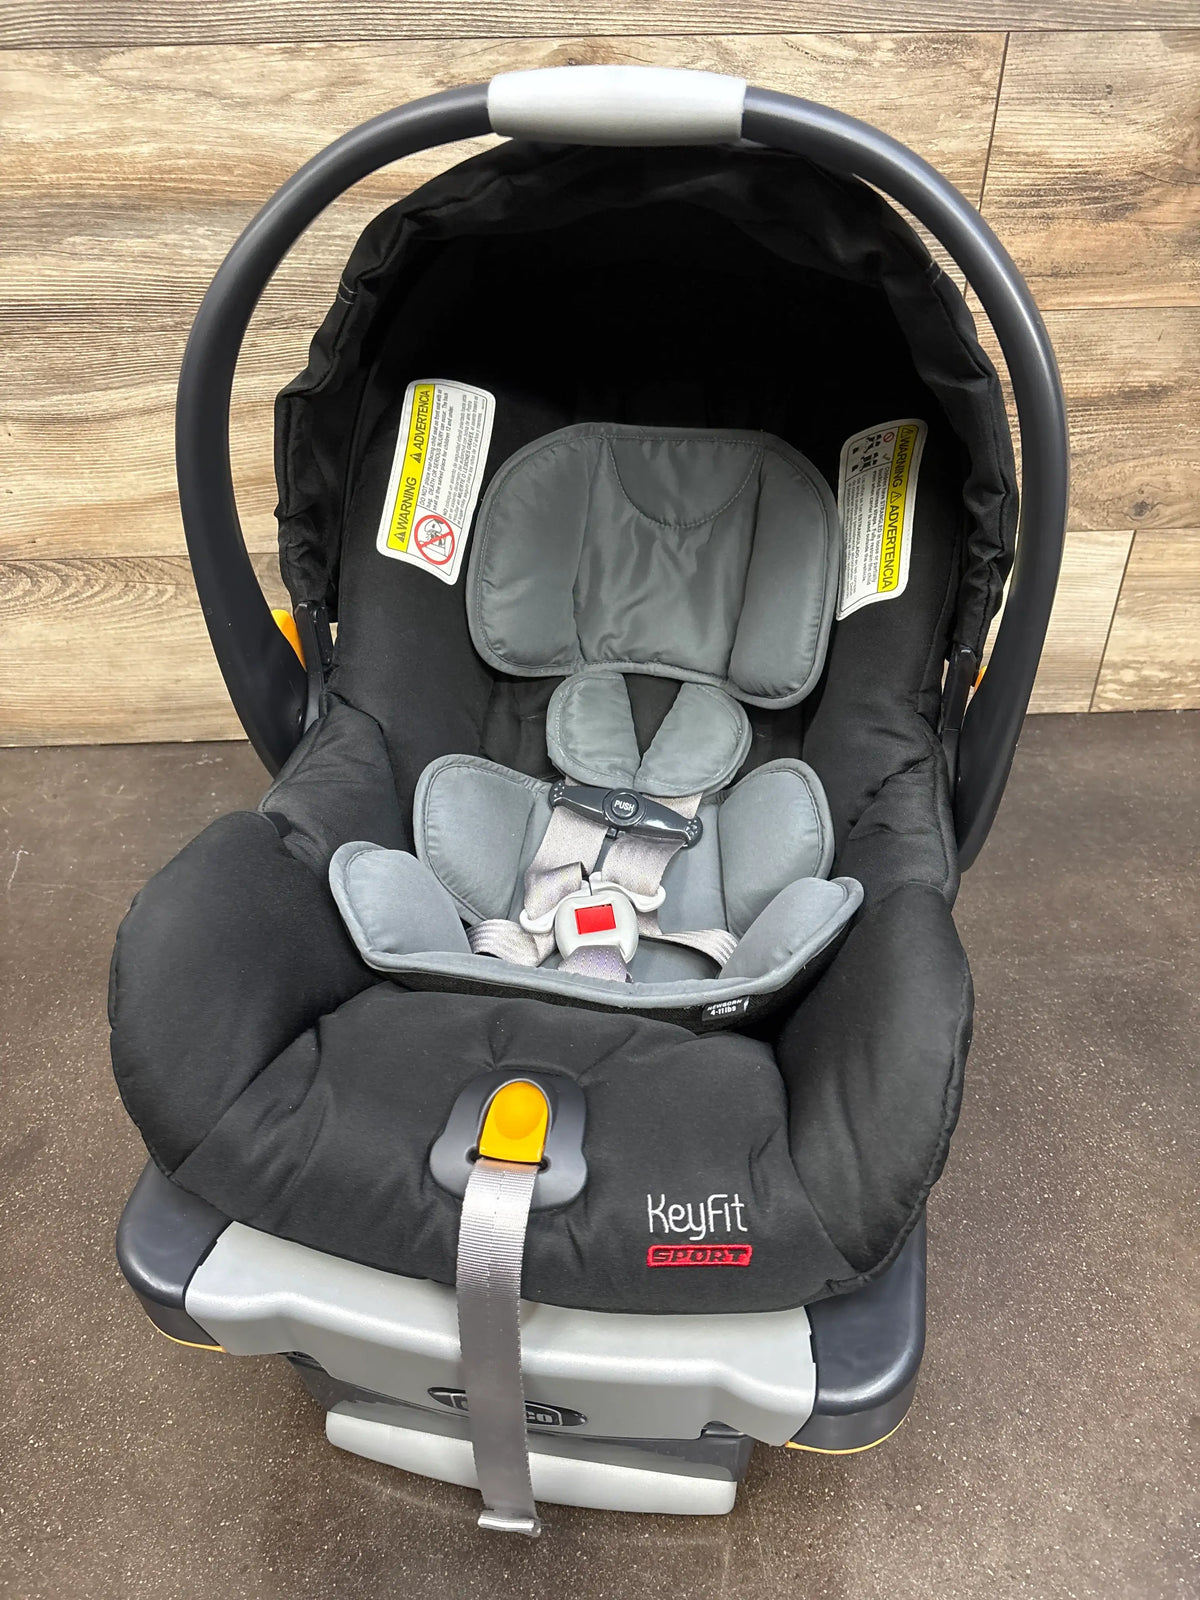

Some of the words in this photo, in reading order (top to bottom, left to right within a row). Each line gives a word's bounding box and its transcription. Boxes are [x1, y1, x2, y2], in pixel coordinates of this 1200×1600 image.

[436, 430, 444, 447] INJURY
[396, 476, 417, 530] WARNING
[414, 390, 430, 451] ADVERTENCIA
[432, 447, 441, 469] SERIOUS
[439, 457, 447, 471] place
[892, 437, 910, 488] WARNING
[431, 468, 437, 477] OR
[419, 496, 425, 505] DO
[423, 471, 431, 485] place
[427, 477, 436, 495] DEATH
[877, 499, 885, 532] STRANGLED
[882, 505, 899, 589] ADVERTENCIA
[614, 800, 635, 811] PUSH
[646, 1193, 748, 1241] KeyFit
[650, 1247, 750, 1264] SPORT
